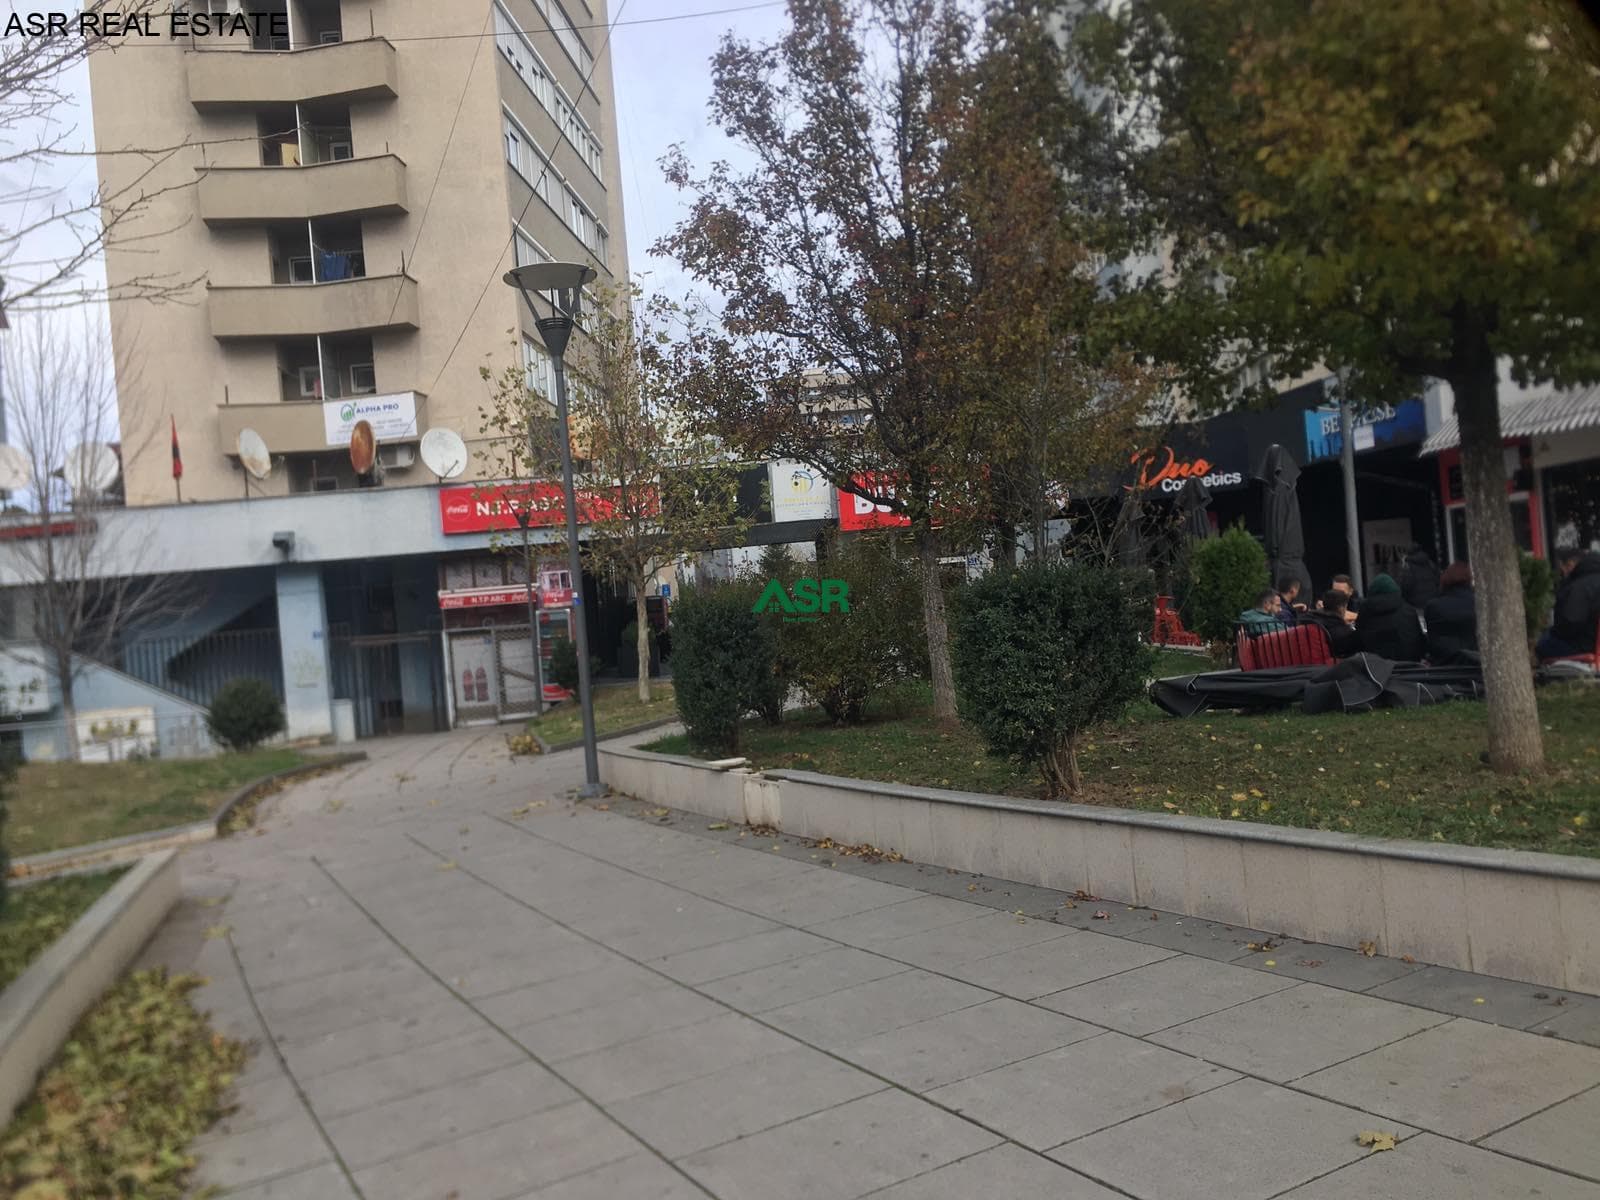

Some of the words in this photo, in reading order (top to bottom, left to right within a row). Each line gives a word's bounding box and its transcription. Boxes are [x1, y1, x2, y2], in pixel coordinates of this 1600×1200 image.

[356, 405, 381, 415] ALPHA
[383, 402, 400, 411] PRO
[1161, 471, 1243, 492] Cosetics
